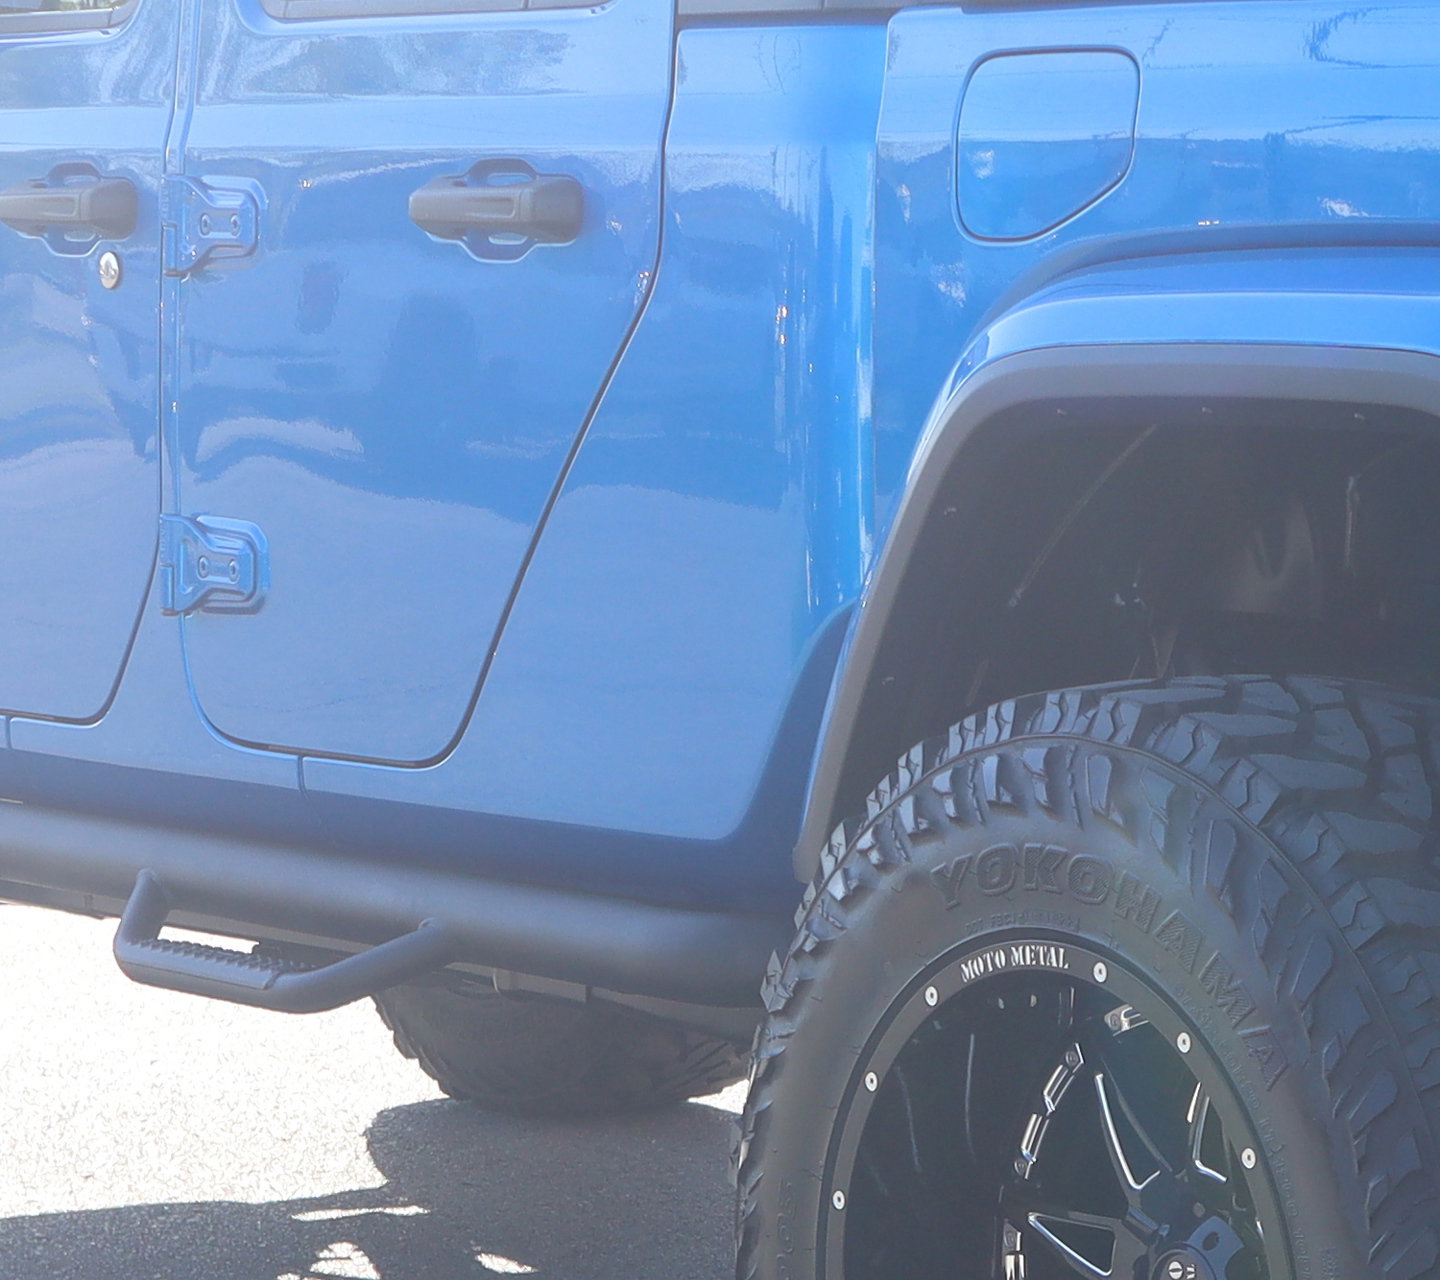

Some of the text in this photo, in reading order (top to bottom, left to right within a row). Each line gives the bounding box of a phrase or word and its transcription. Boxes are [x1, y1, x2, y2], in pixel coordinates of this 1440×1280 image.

[931, 841, 1290, 1092] YOKOHAMA
[960, 942, 1071, 984] MOTO METAL
